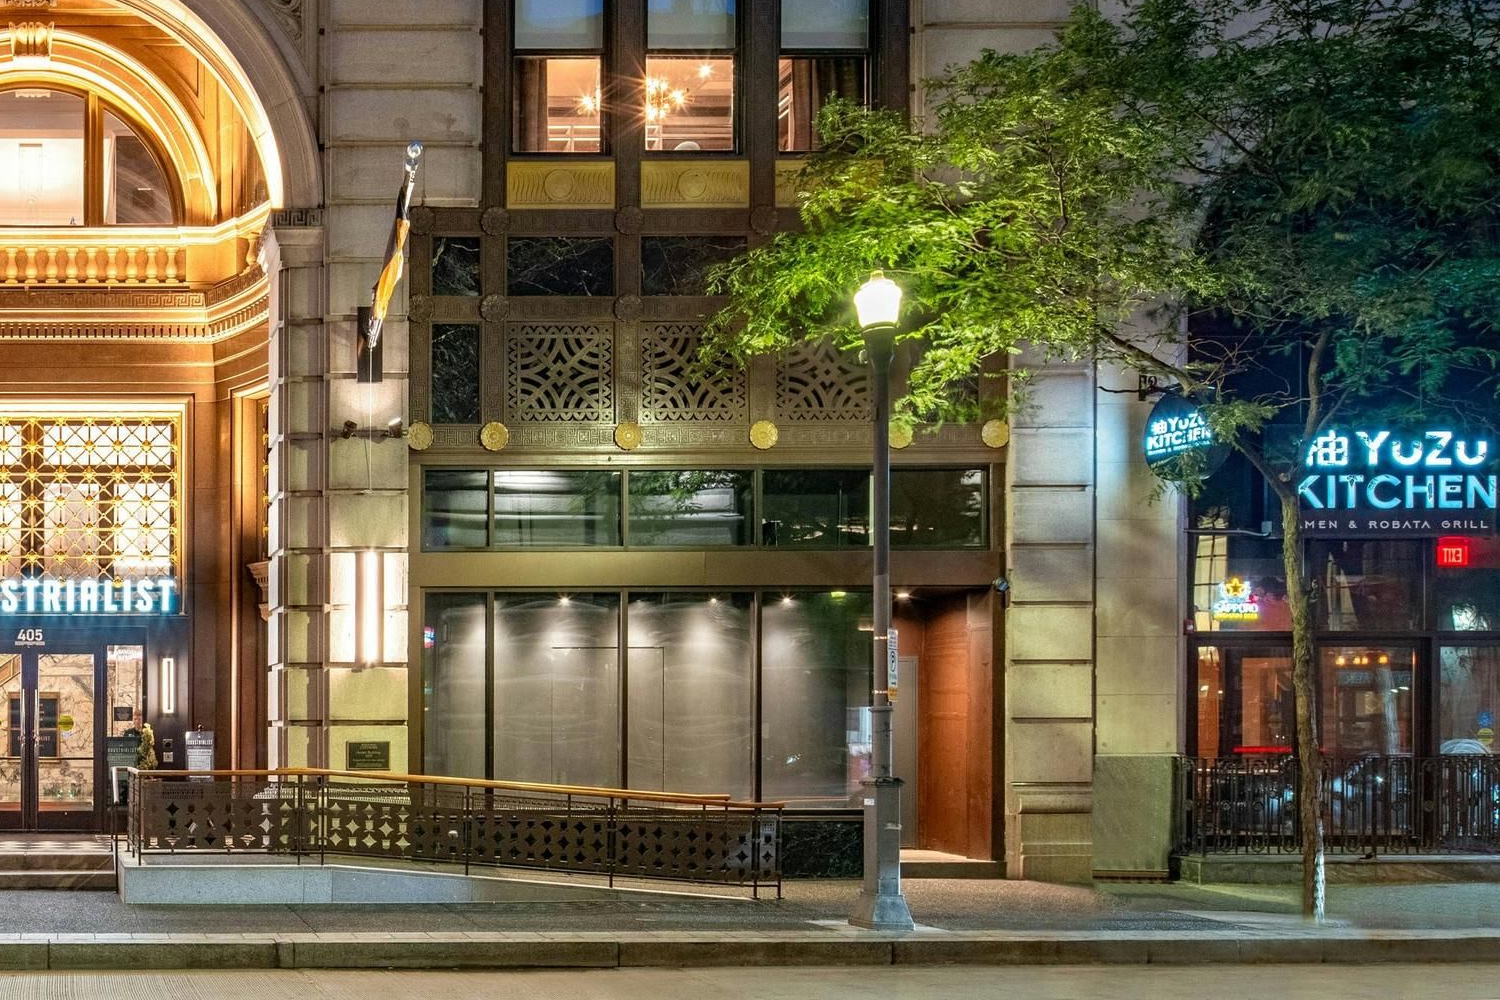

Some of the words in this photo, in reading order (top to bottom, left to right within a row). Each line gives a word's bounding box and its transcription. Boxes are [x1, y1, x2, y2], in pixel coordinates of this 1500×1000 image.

[1298, 473, 1498, 510] KITCHEN
[1282, 519, 1339, 530] MEN
[1348, 519, 1358, 530] &
[1368, 519, 1432, 530] ROBATA
[1440, 519, 1489, 530] GRILL
[17, 629, 44, 642] 405
